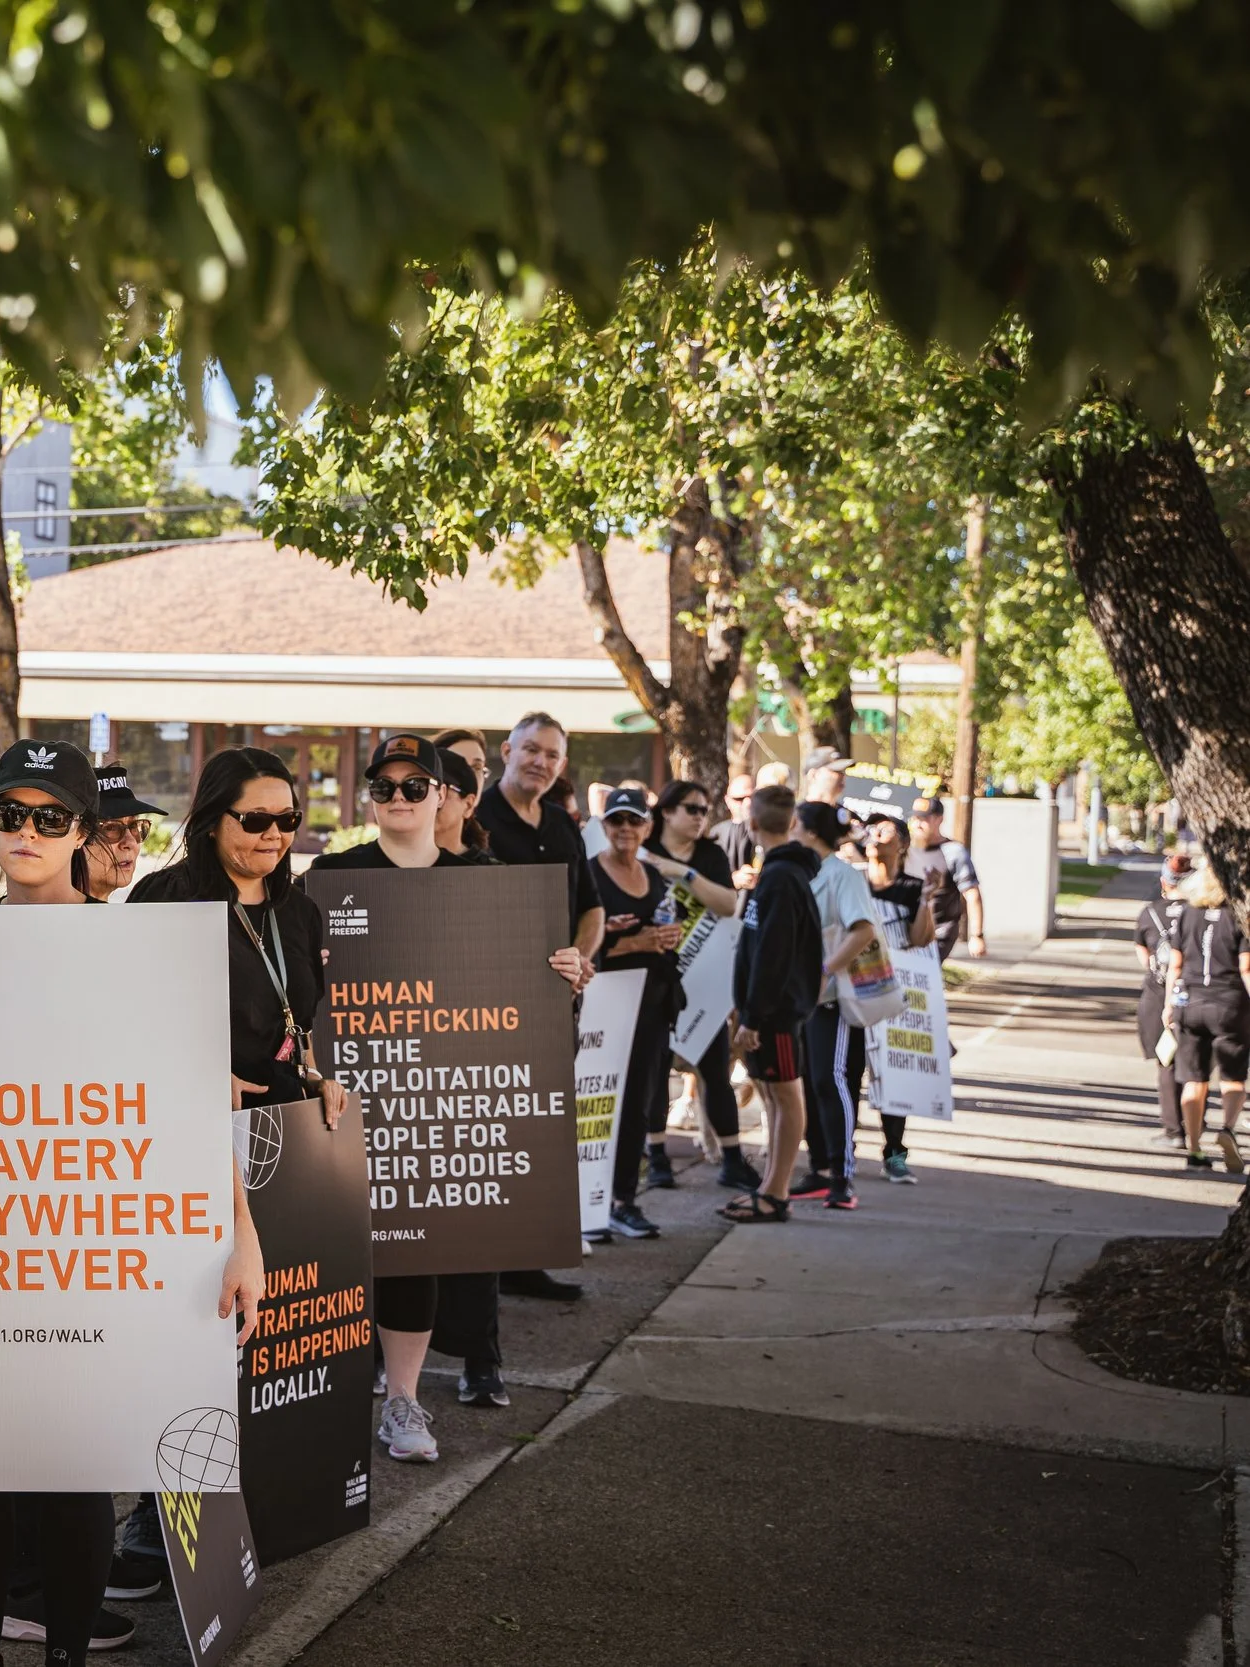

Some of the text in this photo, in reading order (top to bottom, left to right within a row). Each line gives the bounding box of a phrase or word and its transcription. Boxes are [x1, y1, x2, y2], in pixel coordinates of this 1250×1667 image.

[24, 762, 54, 770] adidas
[328, 909, 353, 918] WALK
[329, 918, 346, 927] FOR
[329, 927, 369, 936] FREEDOM
[331, 980, 434, 1006] HUMAN
[330, 1006, 519, 1036] TRAFFICKING
[333, 1039, 422, 1065] IS THE
[887, 1028, 933, 1053] ENSLAVED
[887, 1050, 915, 1071] RIGHT
[334, 1063, 531, 1094] EXPLOITATION
[380, 1091, 565, 1122] VULNERABLE
[453, 1123, 508, 1149] FOR
[430, 1150, 531, 1179] BODIES
[408, 1181, 510, 1209] LABOR.
[262, 1261, 318, 1301] UMAN
[255, 1285, 364, 1339] TRAFFICKING
[252, 1346, 269, 1377] IS
[275, 1318, 372, 1371] HAPPENING
[250, 1365, 332, 1415] LOCALLY.
